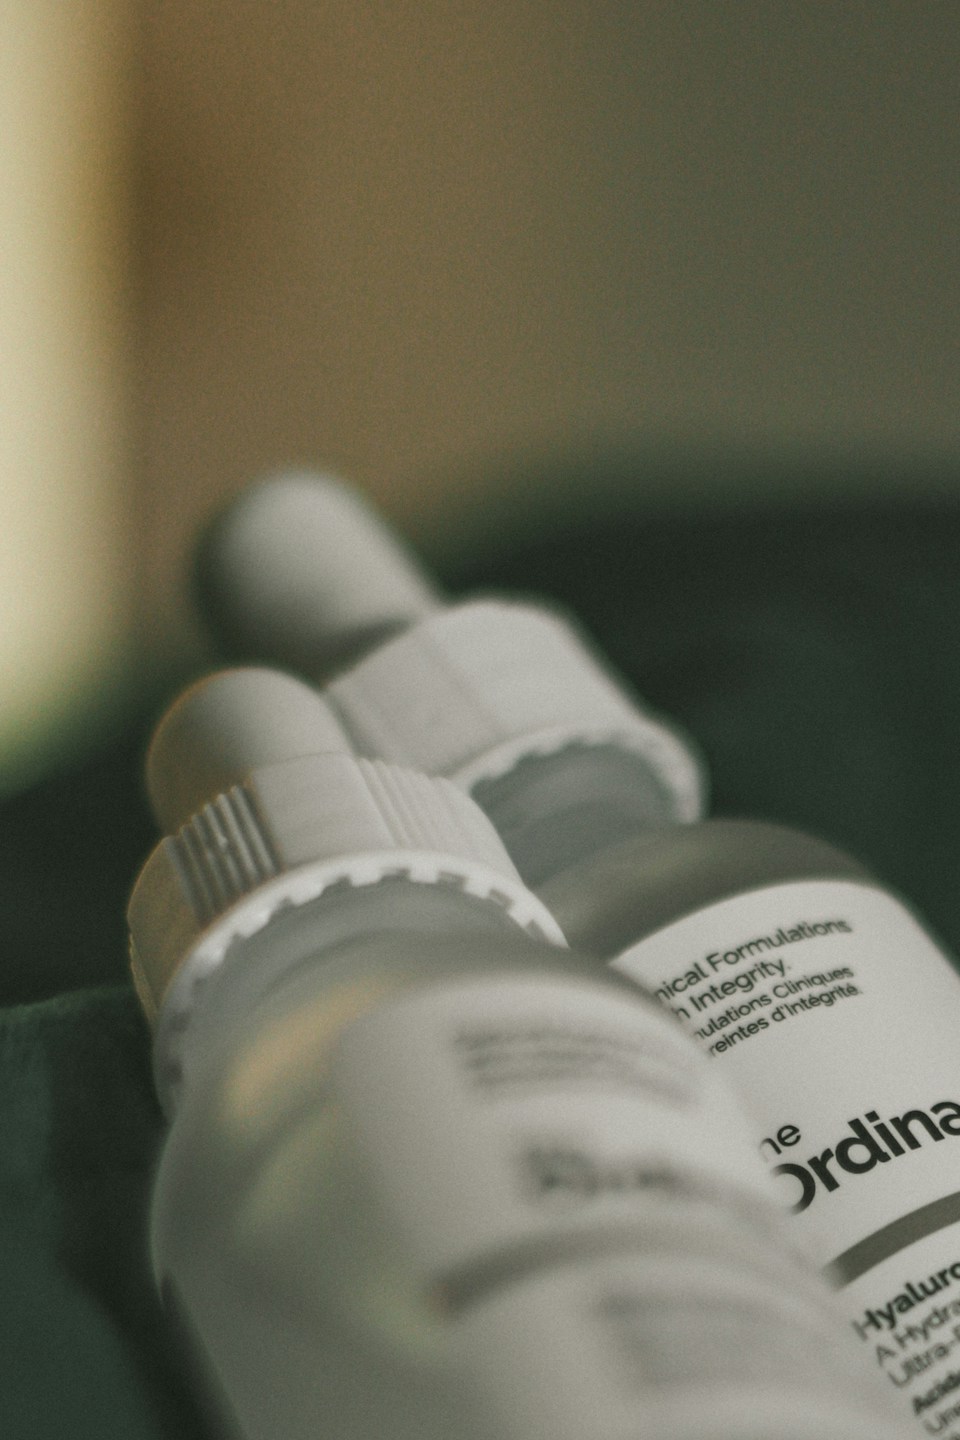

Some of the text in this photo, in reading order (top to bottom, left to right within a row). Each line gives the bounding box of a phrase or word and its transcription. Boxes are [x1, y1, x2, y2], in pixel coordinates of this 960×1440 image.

[652, 919, 853, 1001] nical Formulations
[694, 967, 854, 1040] ulations Cliniques
[709, 1017, 769, 1057] reintes
[876, 1345, 896, 1367] A
